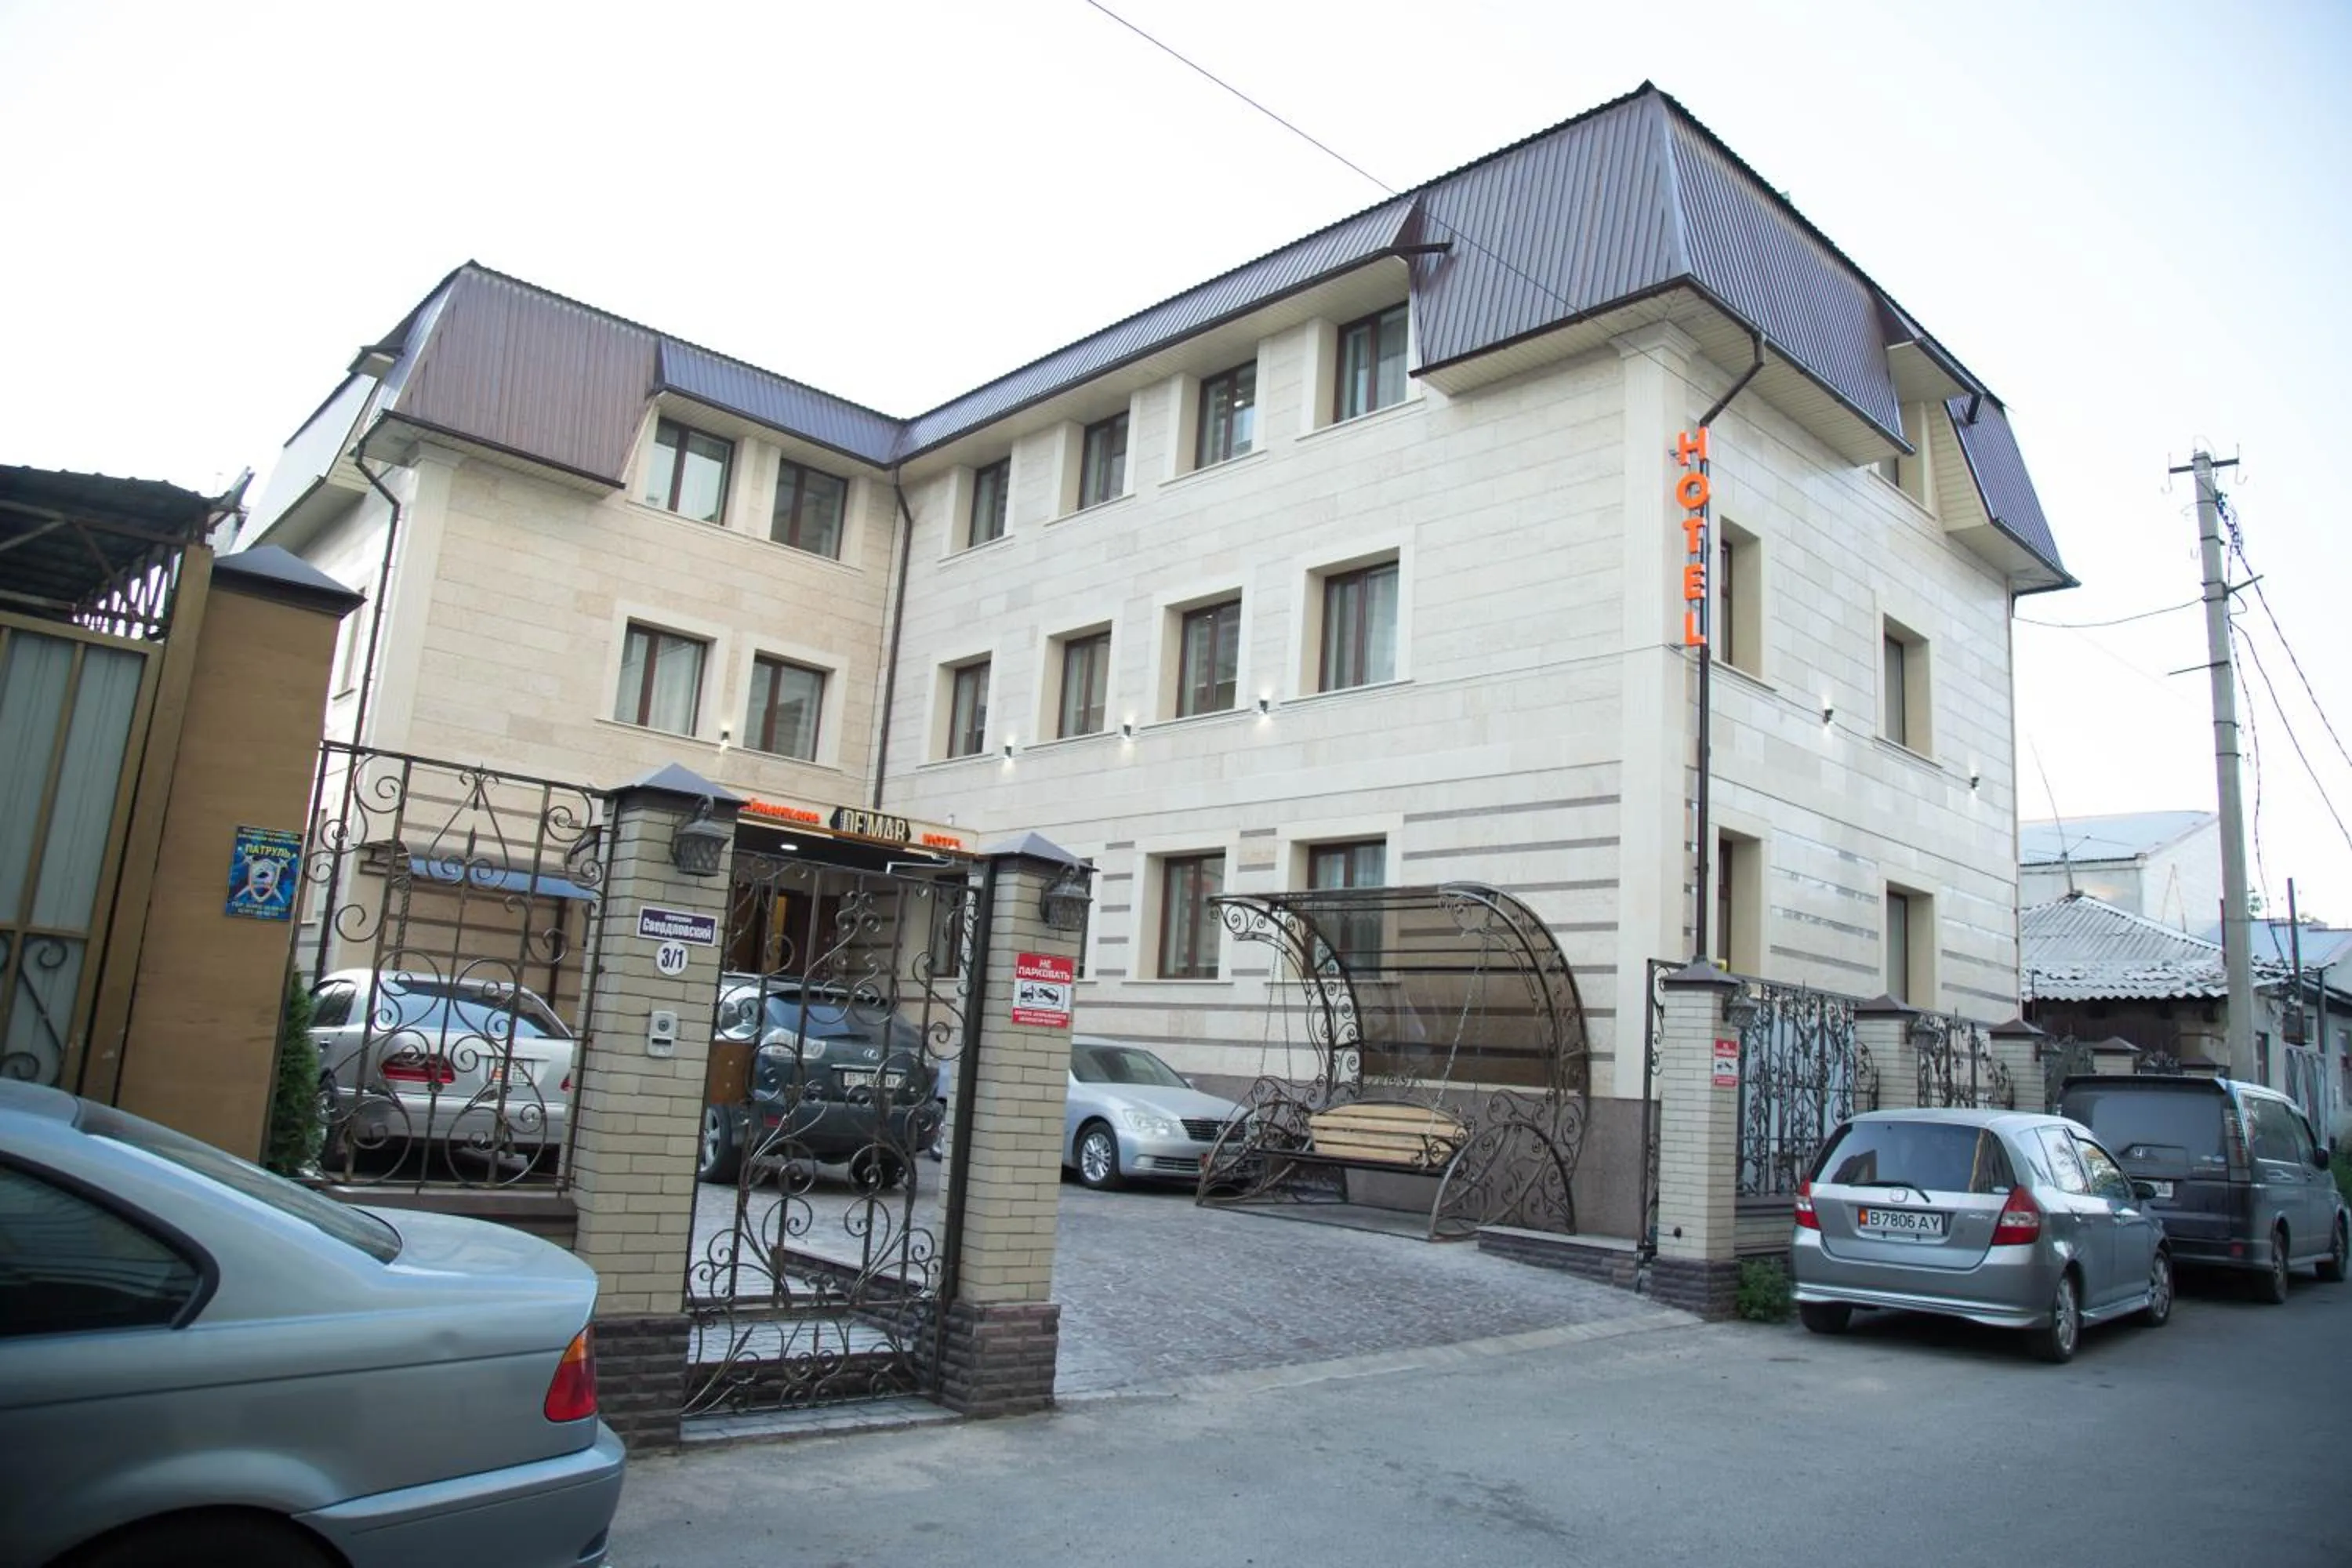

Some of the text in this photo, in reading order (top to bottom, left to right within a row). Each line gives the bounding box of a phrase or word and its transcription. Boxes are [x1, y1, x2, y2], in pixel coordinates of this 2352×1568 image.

[1676, 426, 1709, 647] HOTEL
[245, 843, 291, 858] ПАТРУЛЬ
[661, 947, 684, 969] 3/1
[1018, 967, 1069, 980] ПАРКОВАТЬ
